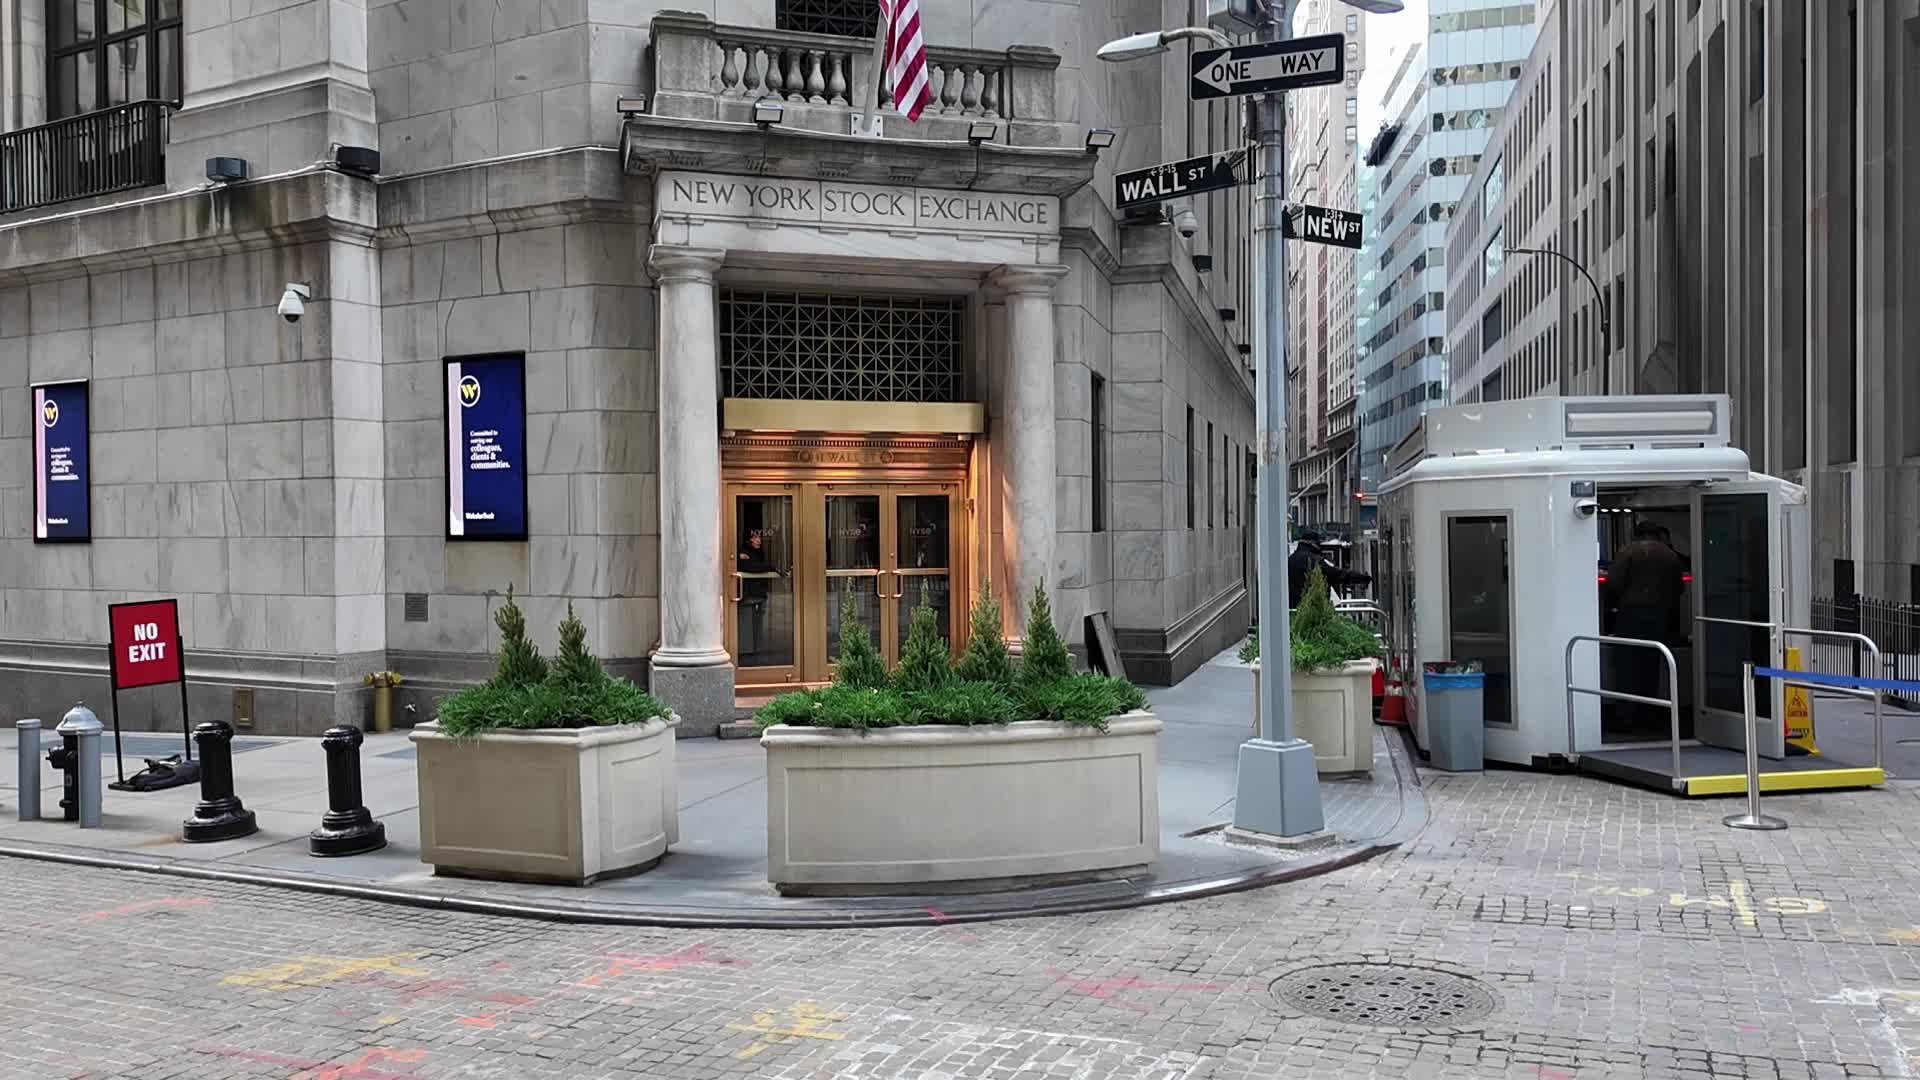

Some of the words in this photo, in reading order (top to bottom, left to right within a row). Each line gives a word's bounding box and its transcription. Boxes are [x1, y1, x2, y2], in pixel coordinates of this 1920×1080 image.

[1211, 61, 1251, 82] ONE
[1280, 51, 1324, 74] WAY
[1122, 172, 1187, 202] WALL
[1188, 166, 1207, 181] ST
[672, 179, 736, 205] NEW
[744, 184, 815, 211] YORK
[824, 190, 905, 216] STOCK
[919, 196, 1048, 225] EXCHANGE
[1307, 214, 1348, 241] NEW
[1348, 221, 1361, 233] ST
[134, 622, 158, 641] NO
[128, 642, 166, 663] EXIT
